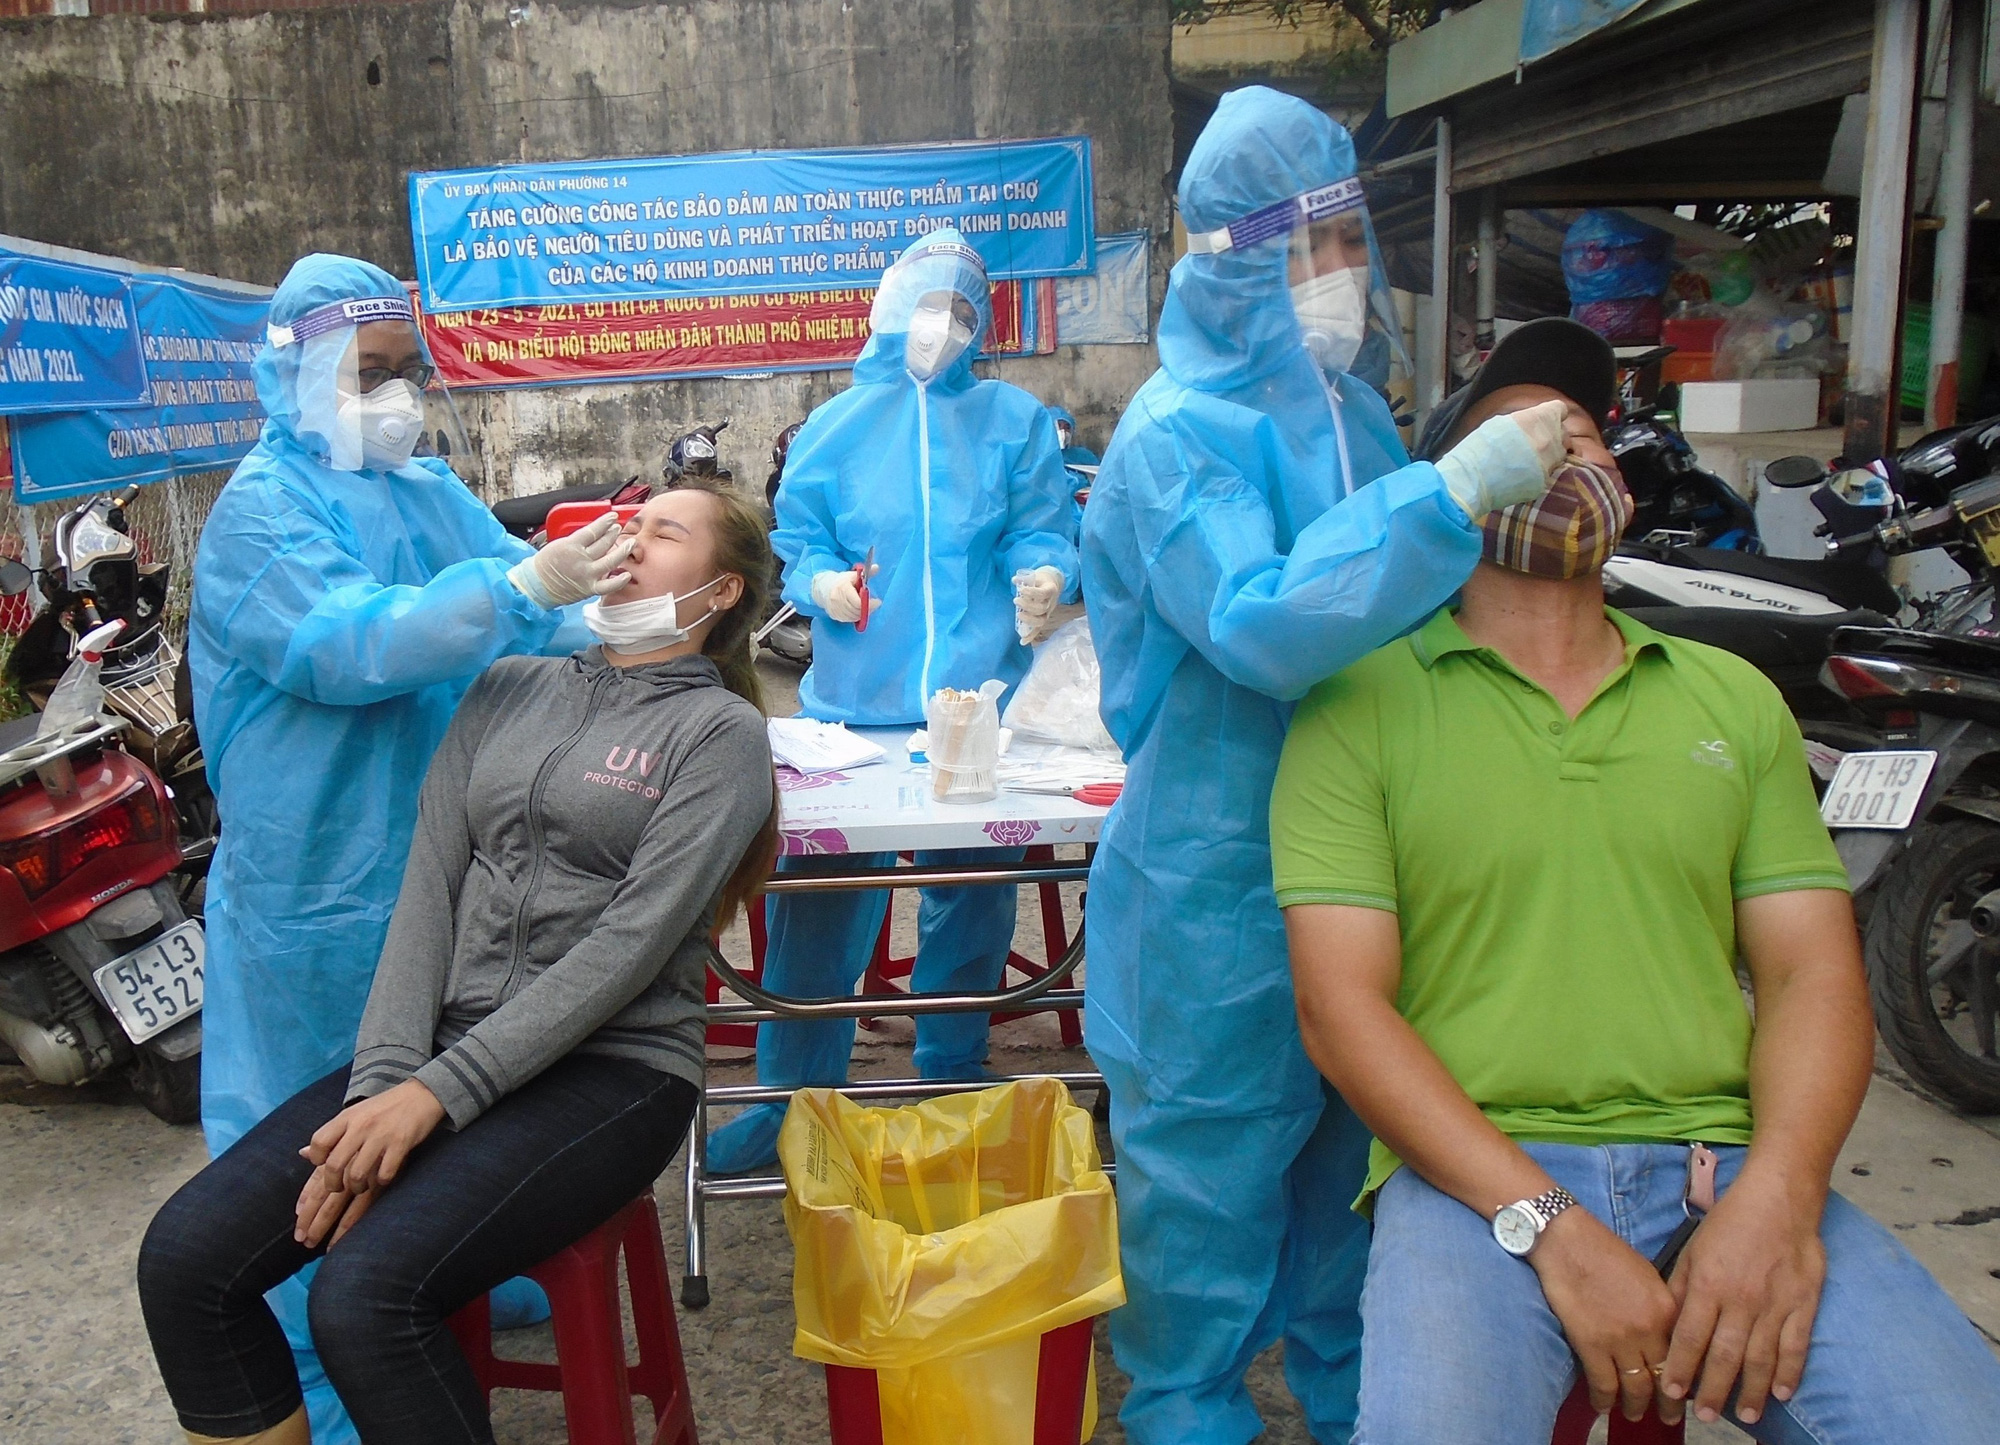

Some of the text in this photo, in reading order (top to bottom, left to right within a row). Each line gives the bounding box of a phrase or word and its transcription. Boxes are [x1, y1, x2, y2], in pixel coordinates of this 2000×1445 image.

[444, 175, 627, 198] ỦY BAN NHÂN DÂN PHƯỜNG 14
[1306, 187, 1343, 208] Face
[468, 178, 1039, 229] TĂNG CƯỜNG CÔNG TÁC BẢO ĐẢM AN TOÀN THỰC PHẨM TẠI CHỢ
[443, 240, 467, 263] LÀ
[473, 234, 510, 260] BẢO
[515, 234, 539, 260] VỆ
[546, 231, 600, 255] NGƯỜI
[605, 230, 647, 253] TIÊU
[653, 227, 703, 250] DÙNG
[708, 224, 732, 247] VÀ
[738, 222, 785, 245] PHÁT
[791, 214, 845, 243] TRIỂN
[851, 219, 898, 242] HOẠT
[960, 213, 1001, 233] KINH
[1008, 210, 1067, 231] DOANH
[548, 260, 586, 285] CỦA
[591, 260, 627, 283] CÁC
[633, 259, 658, 284] HỘ
[664, 259, 707, 280] KINH
[713, 257, 774, 277] DOANH
[779, 252, 828, 276] THỰC
[834, 243, 885, 270] PHẨM
[30, 287, 55, 322] GIA
[55, 285, 92, 326] NƯỚC
[94, 296, 128, 334] SẠCH
[349, 302, 381, 314] Face
[480, 308, 499, 326] 23
[462, 337, 483, 363] VÀ
[488, 340, 514, 364] ĐẠI
[519, 328, 554, 360] BIỂU
[559, 330, 585, 360] HỘI
[590, 324, 631, 354] ĐỒNG
[635, 324, 676, 351] NHÂN
[715, 318, 766, 346] THÀNH
[771, 313, 801, 342] PHỐ
[806, 314, 854, 344] NHIỆM
[7, 341, 45, 382] NĂM
[44, 348, 84, 382] 2021.
[185, 422, 215, 449] DOANH
[1685, 580, 1803, 612] AIR BLADE
[605, 746, 662, 777] UV
[1845, 757, 1918, 788] 71-H3
[583, 771, 662, 800] PROTECTION
[1832, 792, 1901, 822] 9001
[90, 878, 135, 903] HONDA
